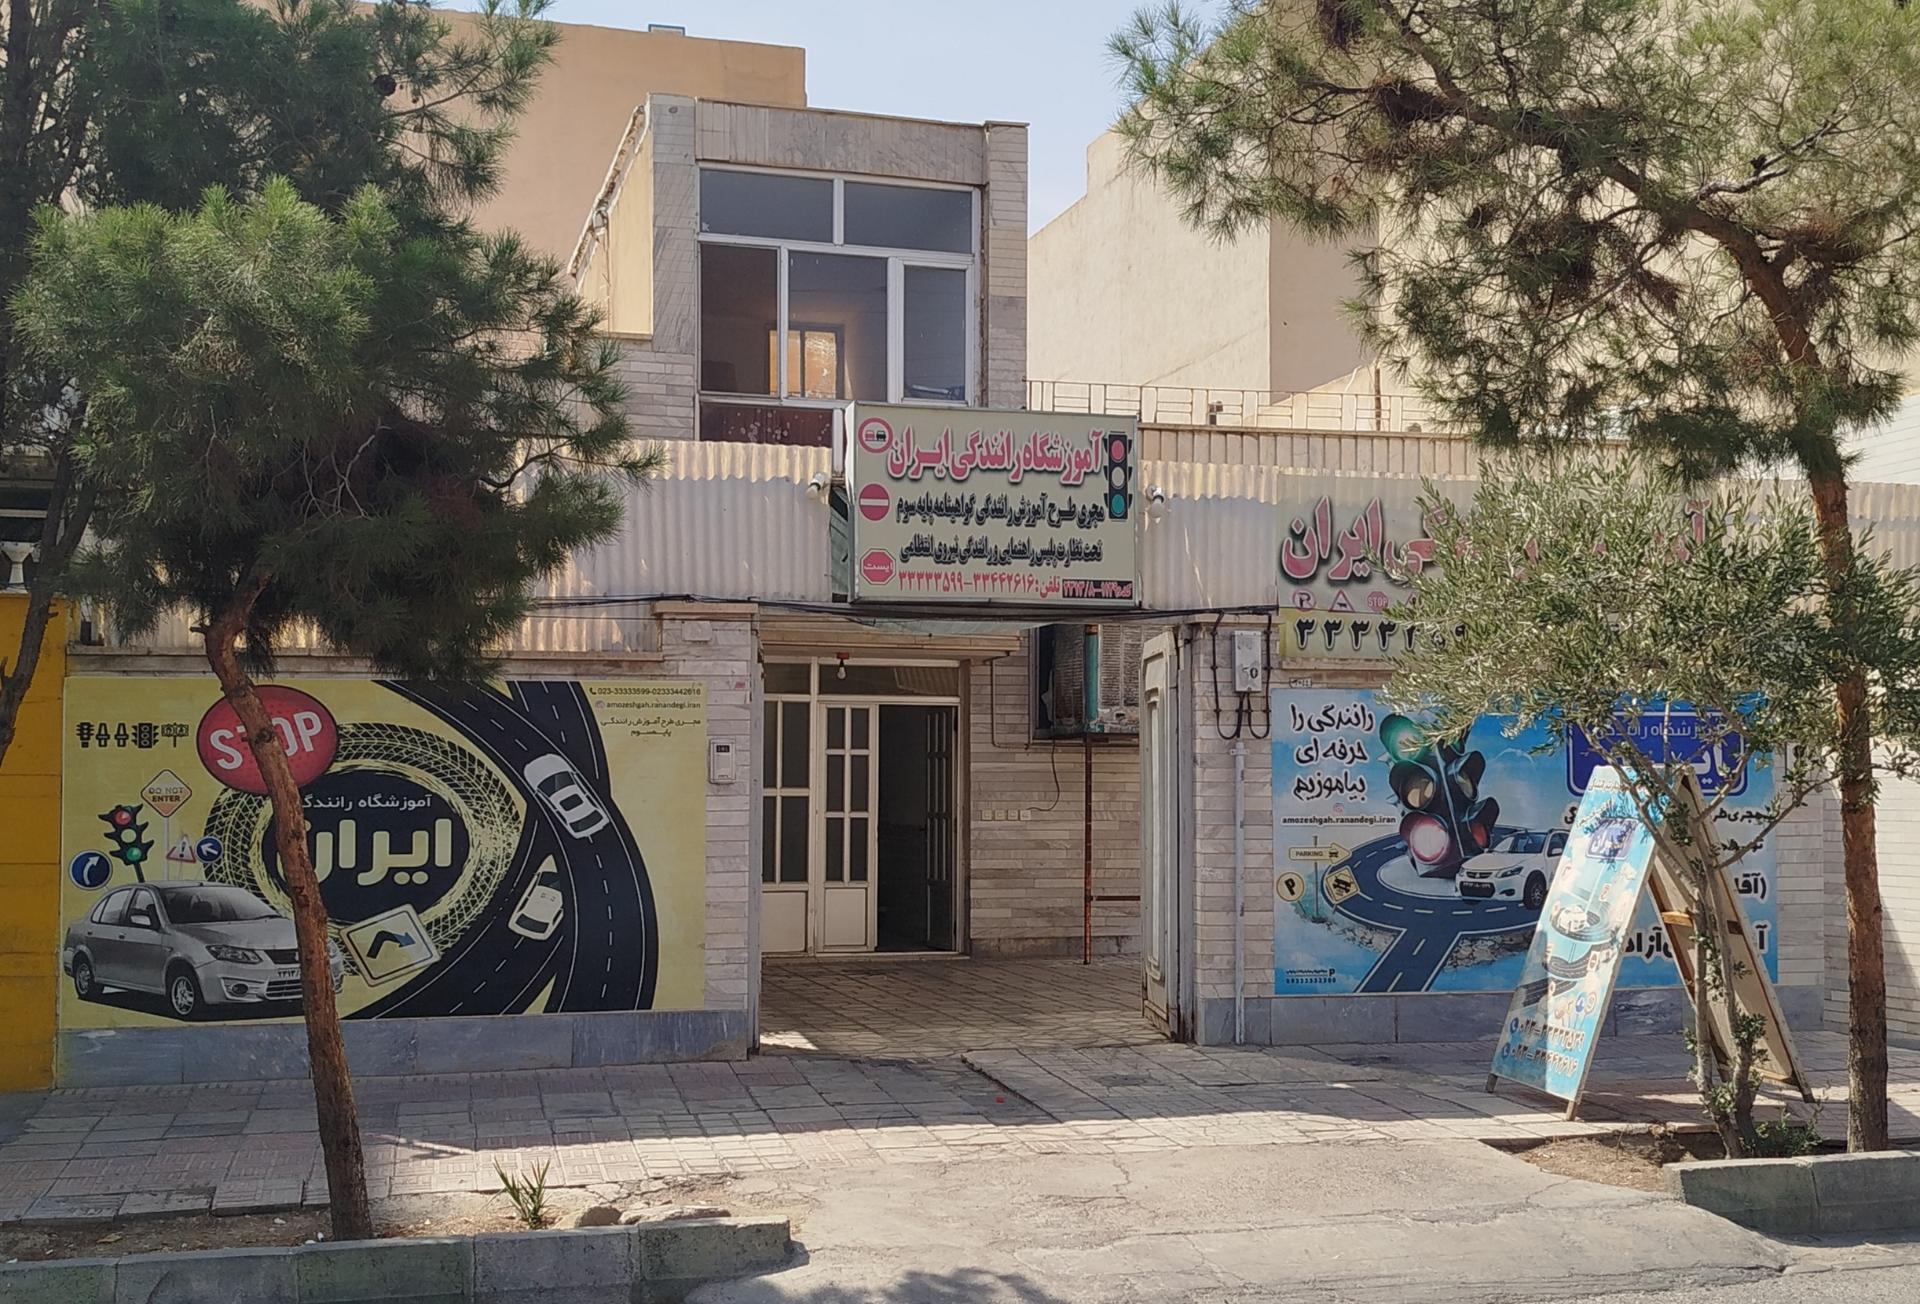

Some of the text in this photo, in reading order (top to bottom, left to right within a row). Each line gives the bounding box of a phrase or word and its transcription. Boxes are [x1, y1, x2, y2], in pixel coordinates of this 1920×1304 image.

[888, 424, 1104, 484] آموزشگاه رانندگی ایران
[896, 496, 917, 523] سوم
[932, 491, 976, 526] گواهینامه
[975, 492, 1014, 526] رانندگی
[1014, 491, 1048, 527] آموزش
[1047, 496, 1077, 528] طرح
[1076, 502, 1105, 529] مجری
[899, 533, 933, 563] انتظامی
[934, 534, 959, 564] نیروی
[959, 534, 993, 565] رانندگی
[1057, 537, 1084, 567] نظارت
[1083, 539, 1103, 562] تحت
[1282, 496, 1382, 580] ایران
[863, 562, 893, 573] ایست
[1368, 596, 1388, 608] STOP
[1290, 703, 1374, 732] رانندگی را
[210, 711, 322, 770] SOP
[1296, 737, 1368, 765] حرفه ای
[1293, 770, 1366, 801] بیاموزیم
[302, 794, 432, 811] آموزشگاه رانندگ
[1282, 816, 1396, 825] amozeshgah.ranandegi.iran
[1284, 878, 1296, 896] P
